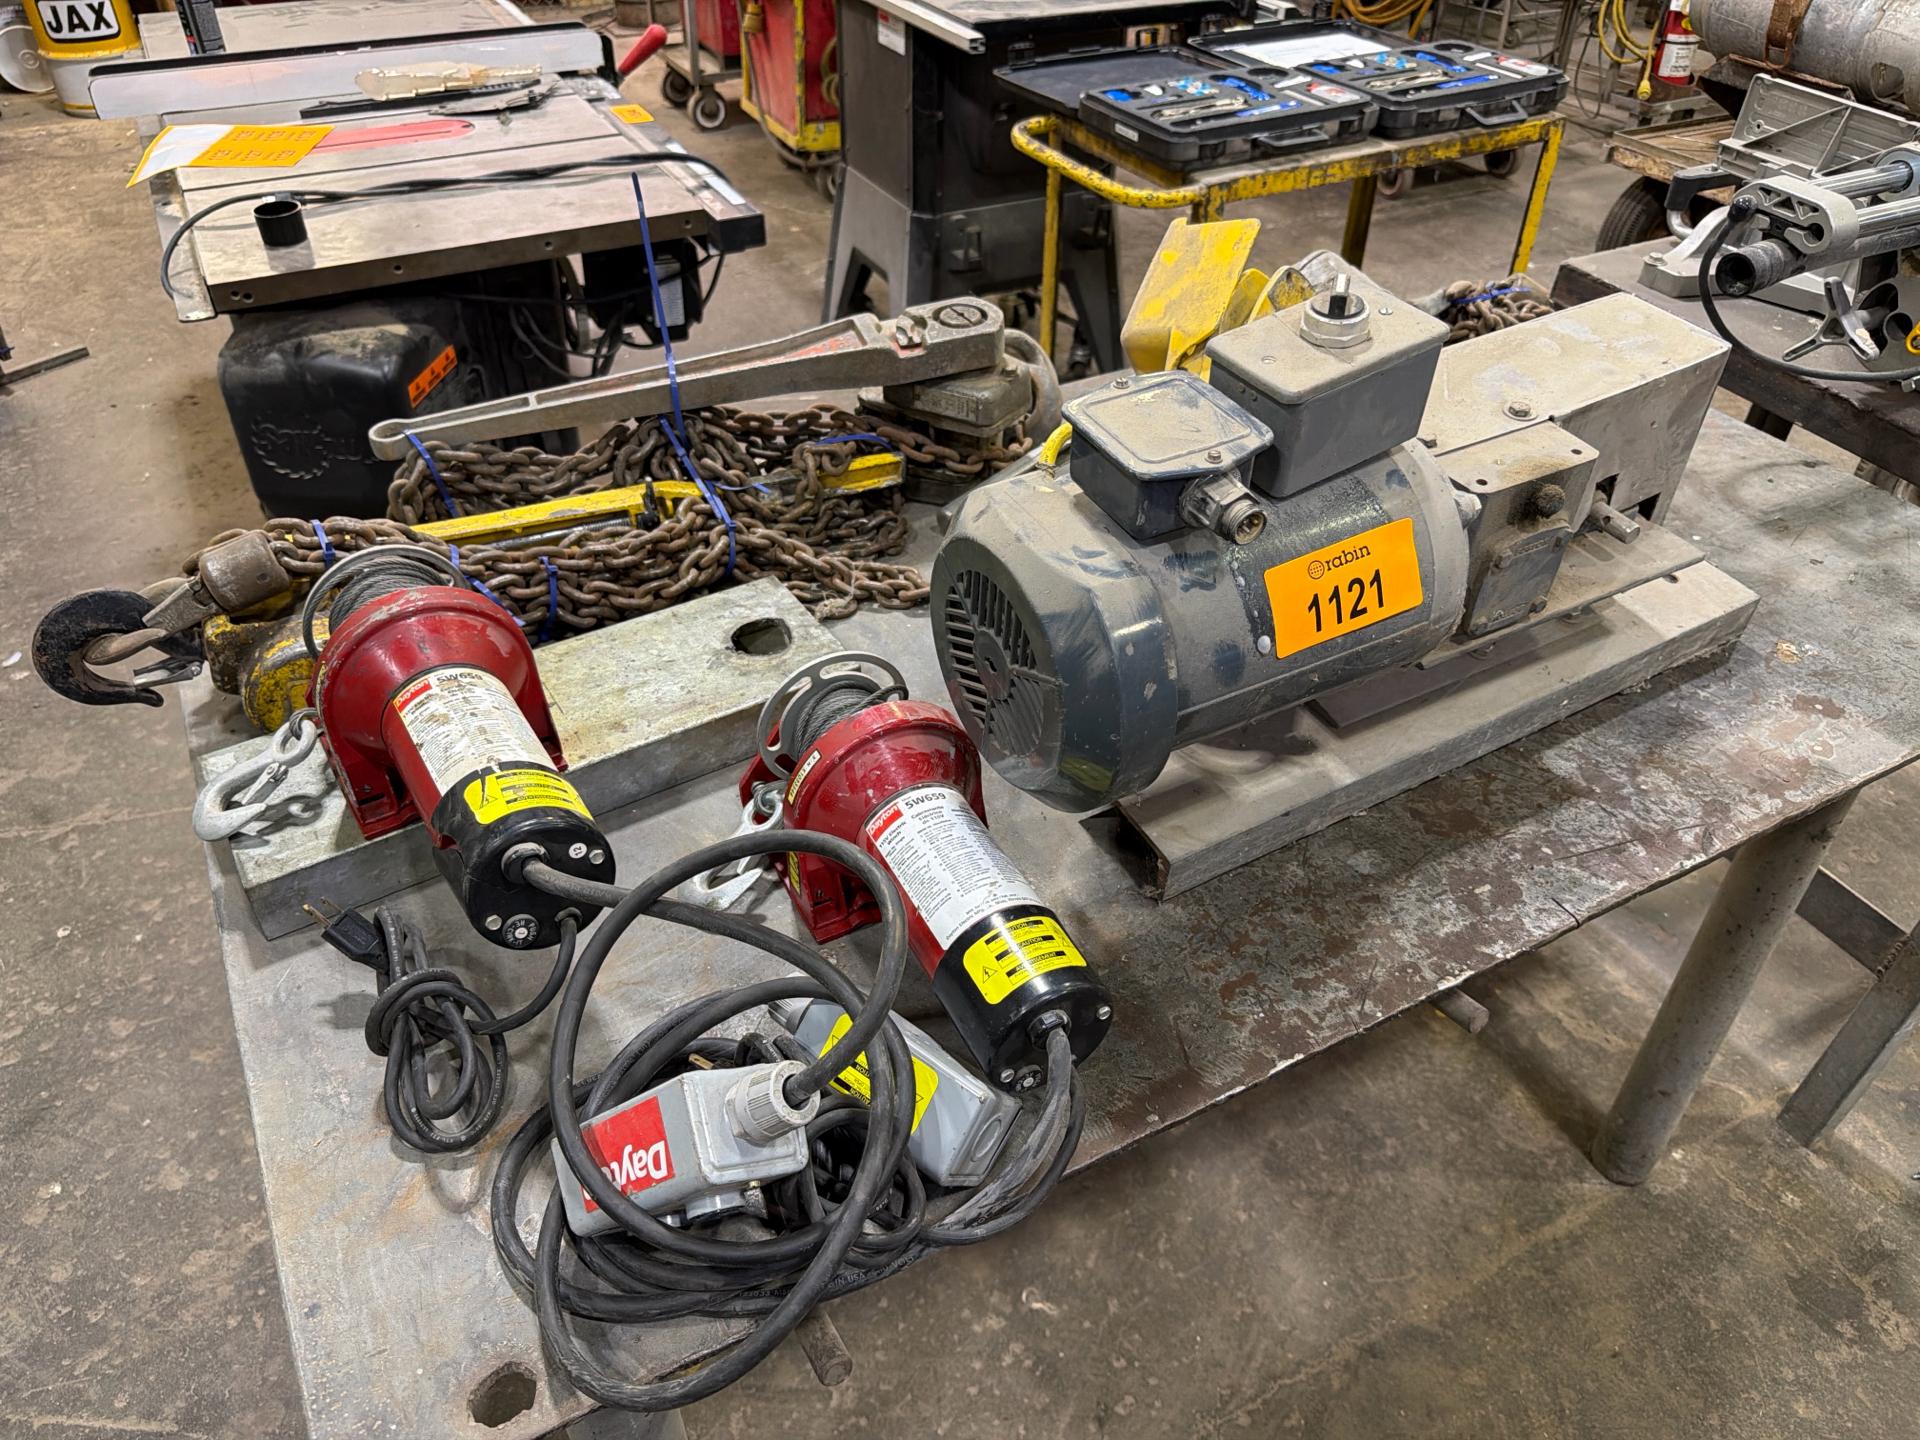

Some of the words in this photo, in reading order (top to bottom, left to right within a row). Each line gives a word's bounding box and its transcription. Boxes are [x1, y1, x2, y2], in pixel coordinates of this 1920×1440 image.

[47, 2, 113, 34] JAX
[1325, 545, 1371, 571] rabin
[1307, 568, 1384, 633] 1121
[396, 679, 429, 708] Dayton
[904, 792, 946, 810] 5W659
[868, 801, 899, 836] Dayton
